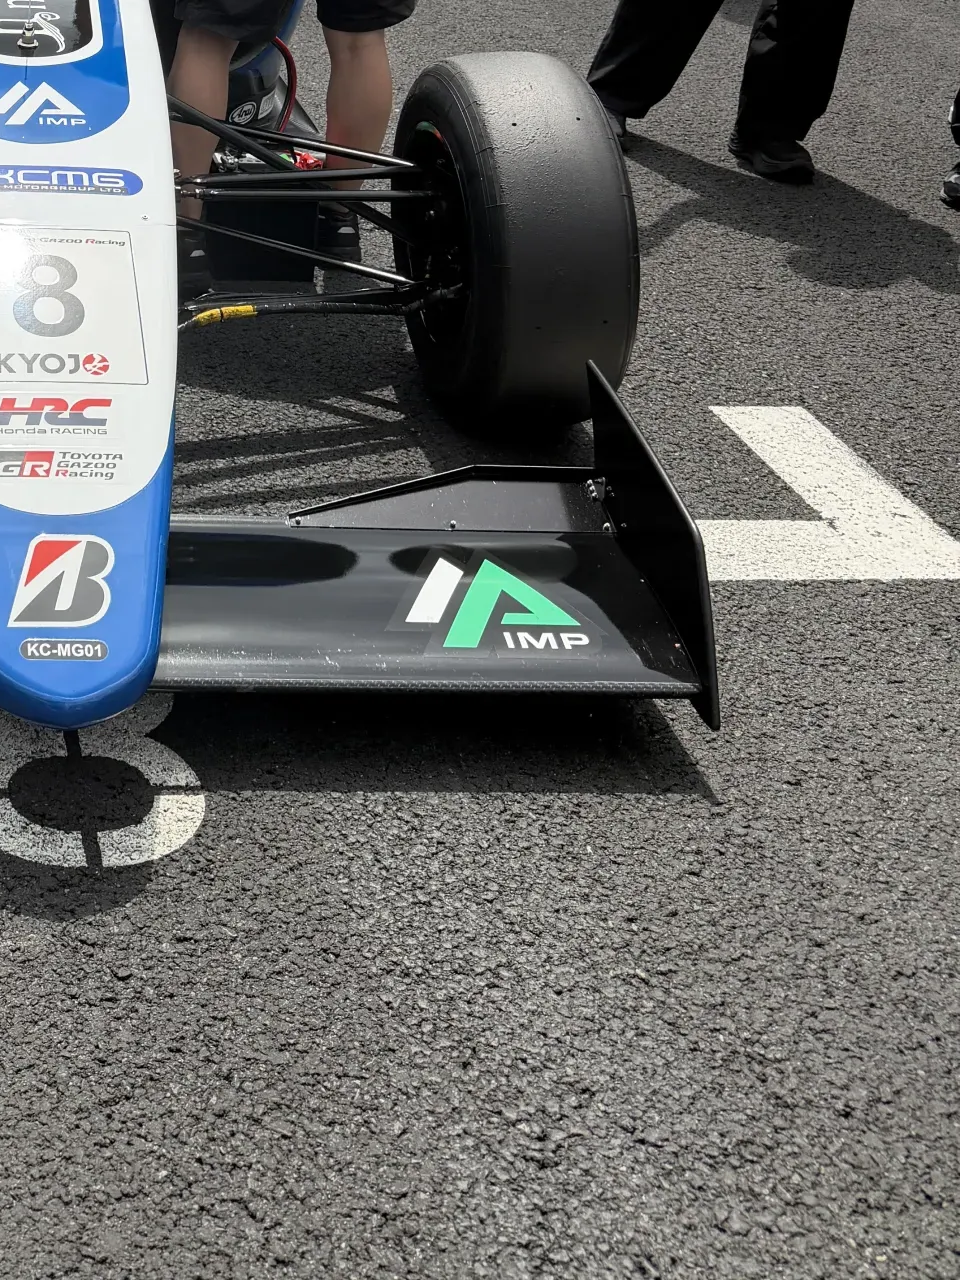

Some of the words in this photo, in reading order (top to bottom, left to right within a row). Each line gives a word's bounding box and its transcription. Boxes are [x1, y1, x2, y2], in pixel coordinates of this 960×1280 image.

[39, 117, 87, 126] IMP
[3, 184, 95, 192] MOTORGROUP
[85, 238, 126, 247] Racing
[12, 253, 86, 338] 8
[50, 427, 108, 435] RACING
[58, 451, 124, 461] TOYOTA
[56, 460, 117, 469] GAZOO
[54, 469, 115, 481] Racing
[502, 631, 590, 650] IMP
[26, 642, 103, 659] KC-MG01
